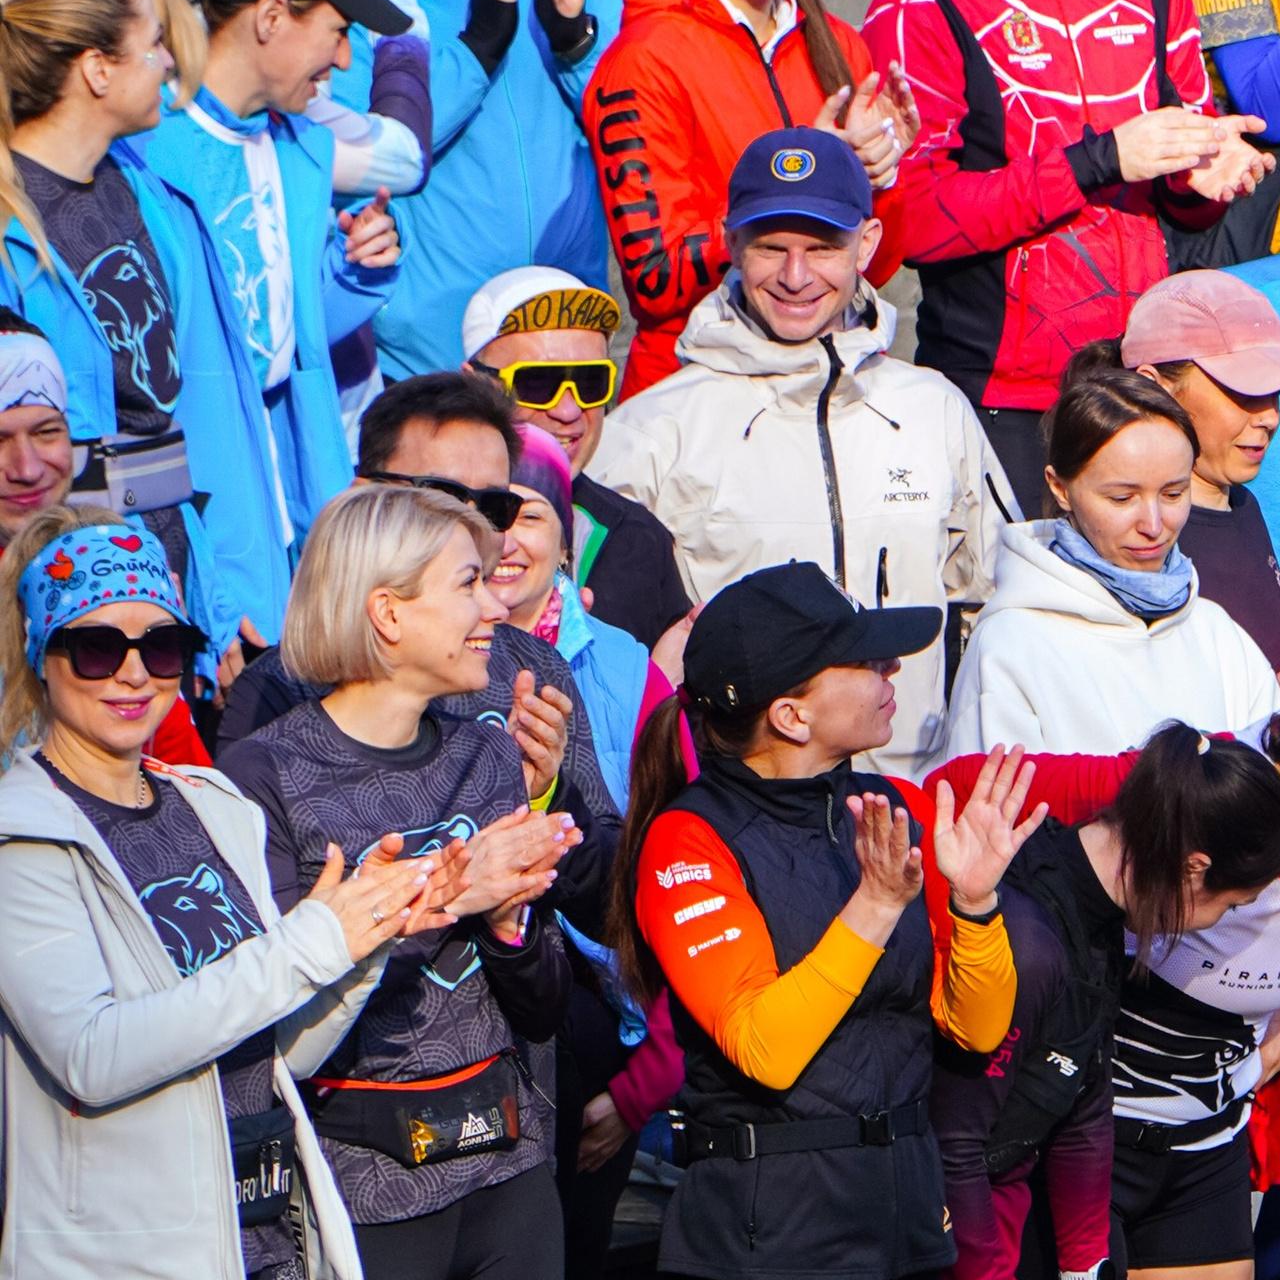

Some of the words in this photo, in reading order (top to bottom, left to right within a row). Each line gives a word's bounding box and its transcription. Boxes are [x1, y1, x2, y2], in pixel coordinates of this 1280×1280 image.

[596, 87, 660, 222] JUST
[674, 869, 712, 885] BRICS
[674, 896, 726, 925] СИБУР
[1218, 980, 1273, 990] RUNNING
[457, 1132, 497, 1148] AONIJIE
